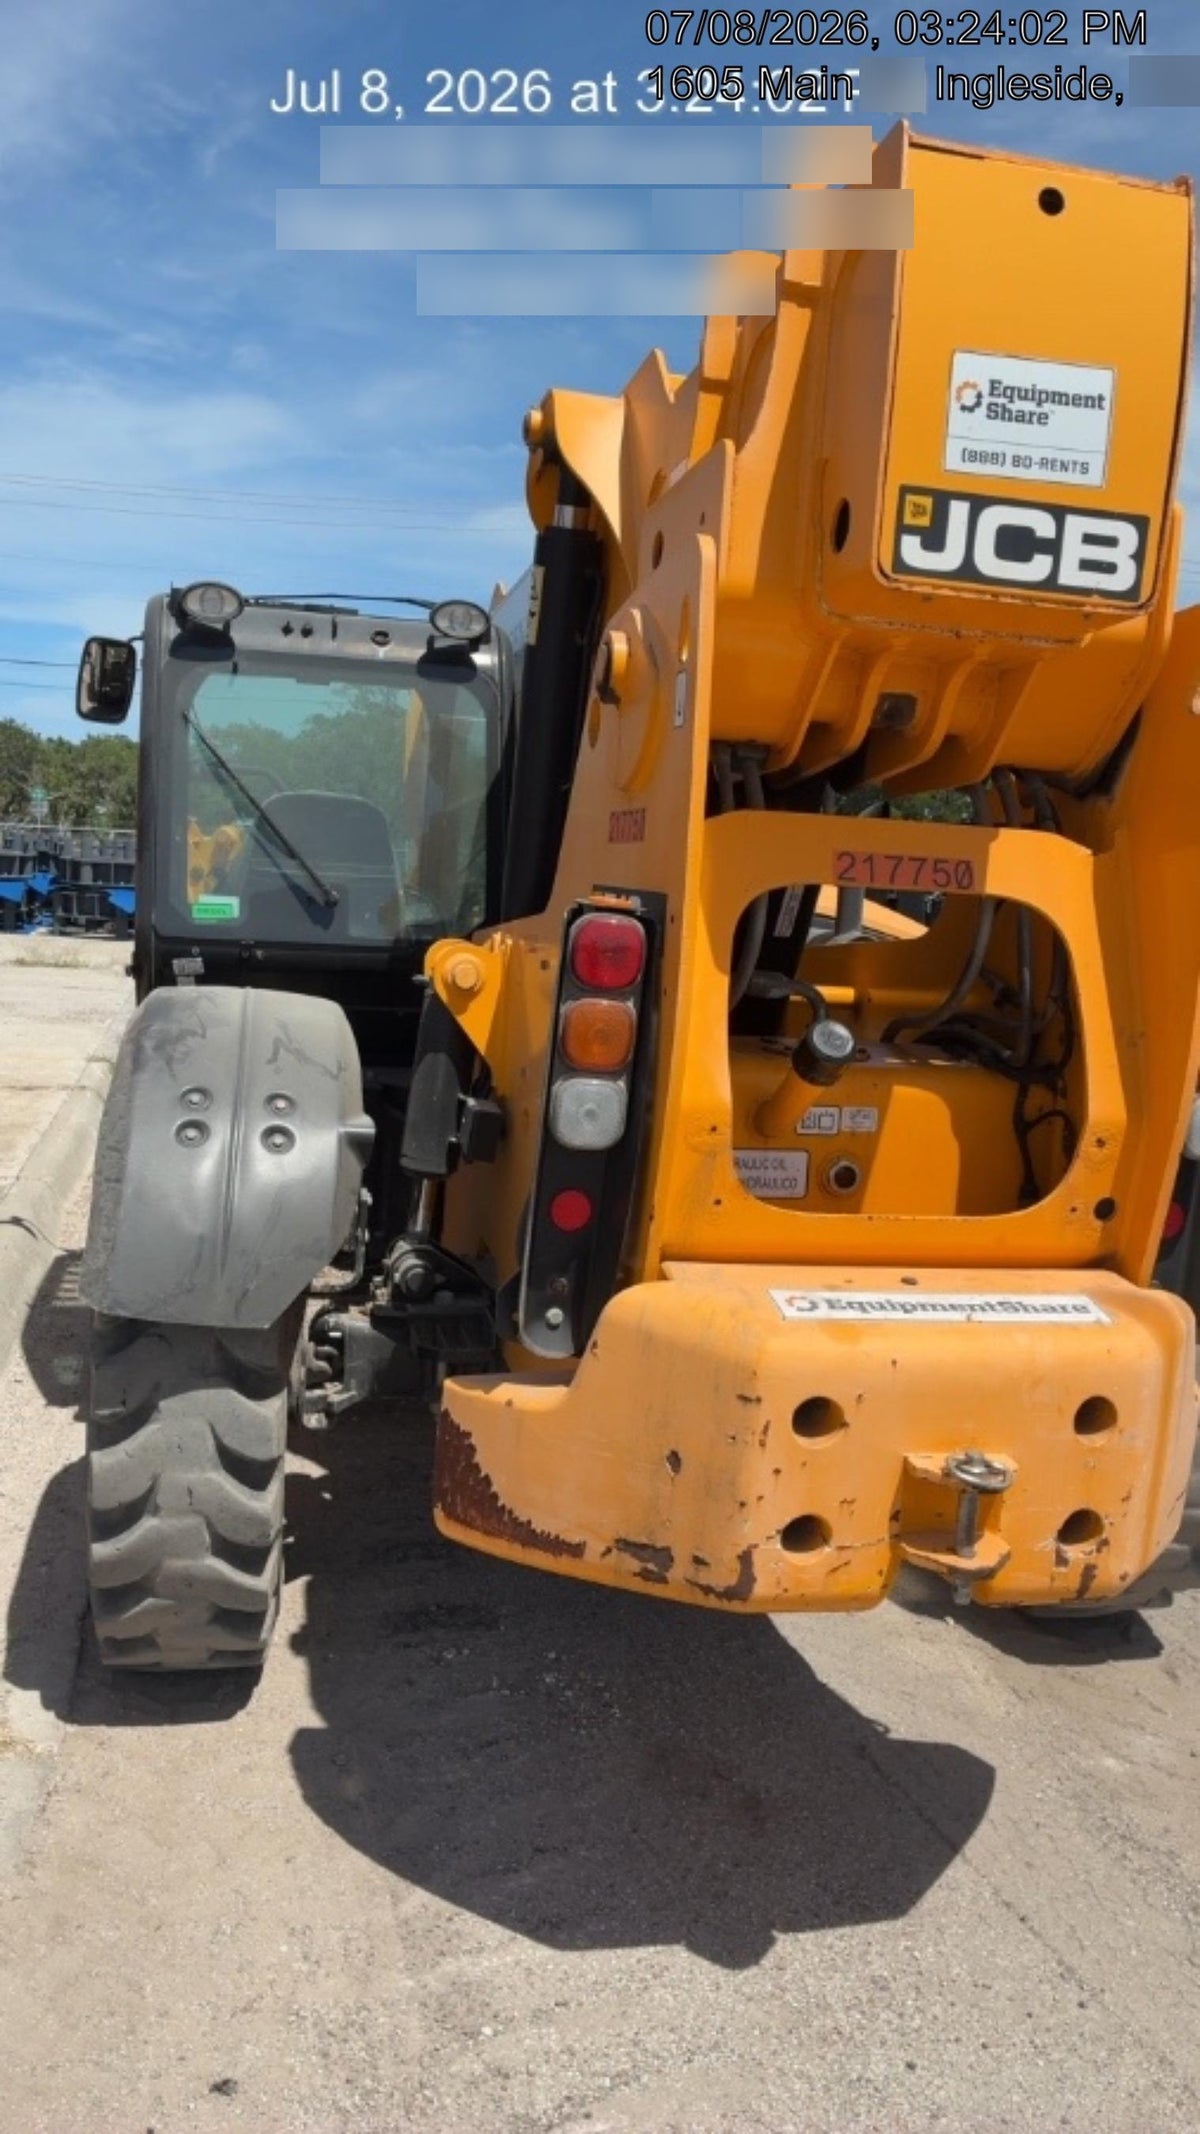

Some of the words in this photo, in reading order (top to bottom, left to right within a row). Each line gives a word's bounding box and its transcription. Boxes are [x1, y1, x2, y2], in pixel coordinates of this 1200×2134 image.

[987, 379, 1106, 411] Equipment
[985, 402, 1050, 426] Share
[900, 499, 1139, 592] JCB
[836, 850, 974, 891] 217750
[827, 1297, 1092, 1315] EquipmentShare
